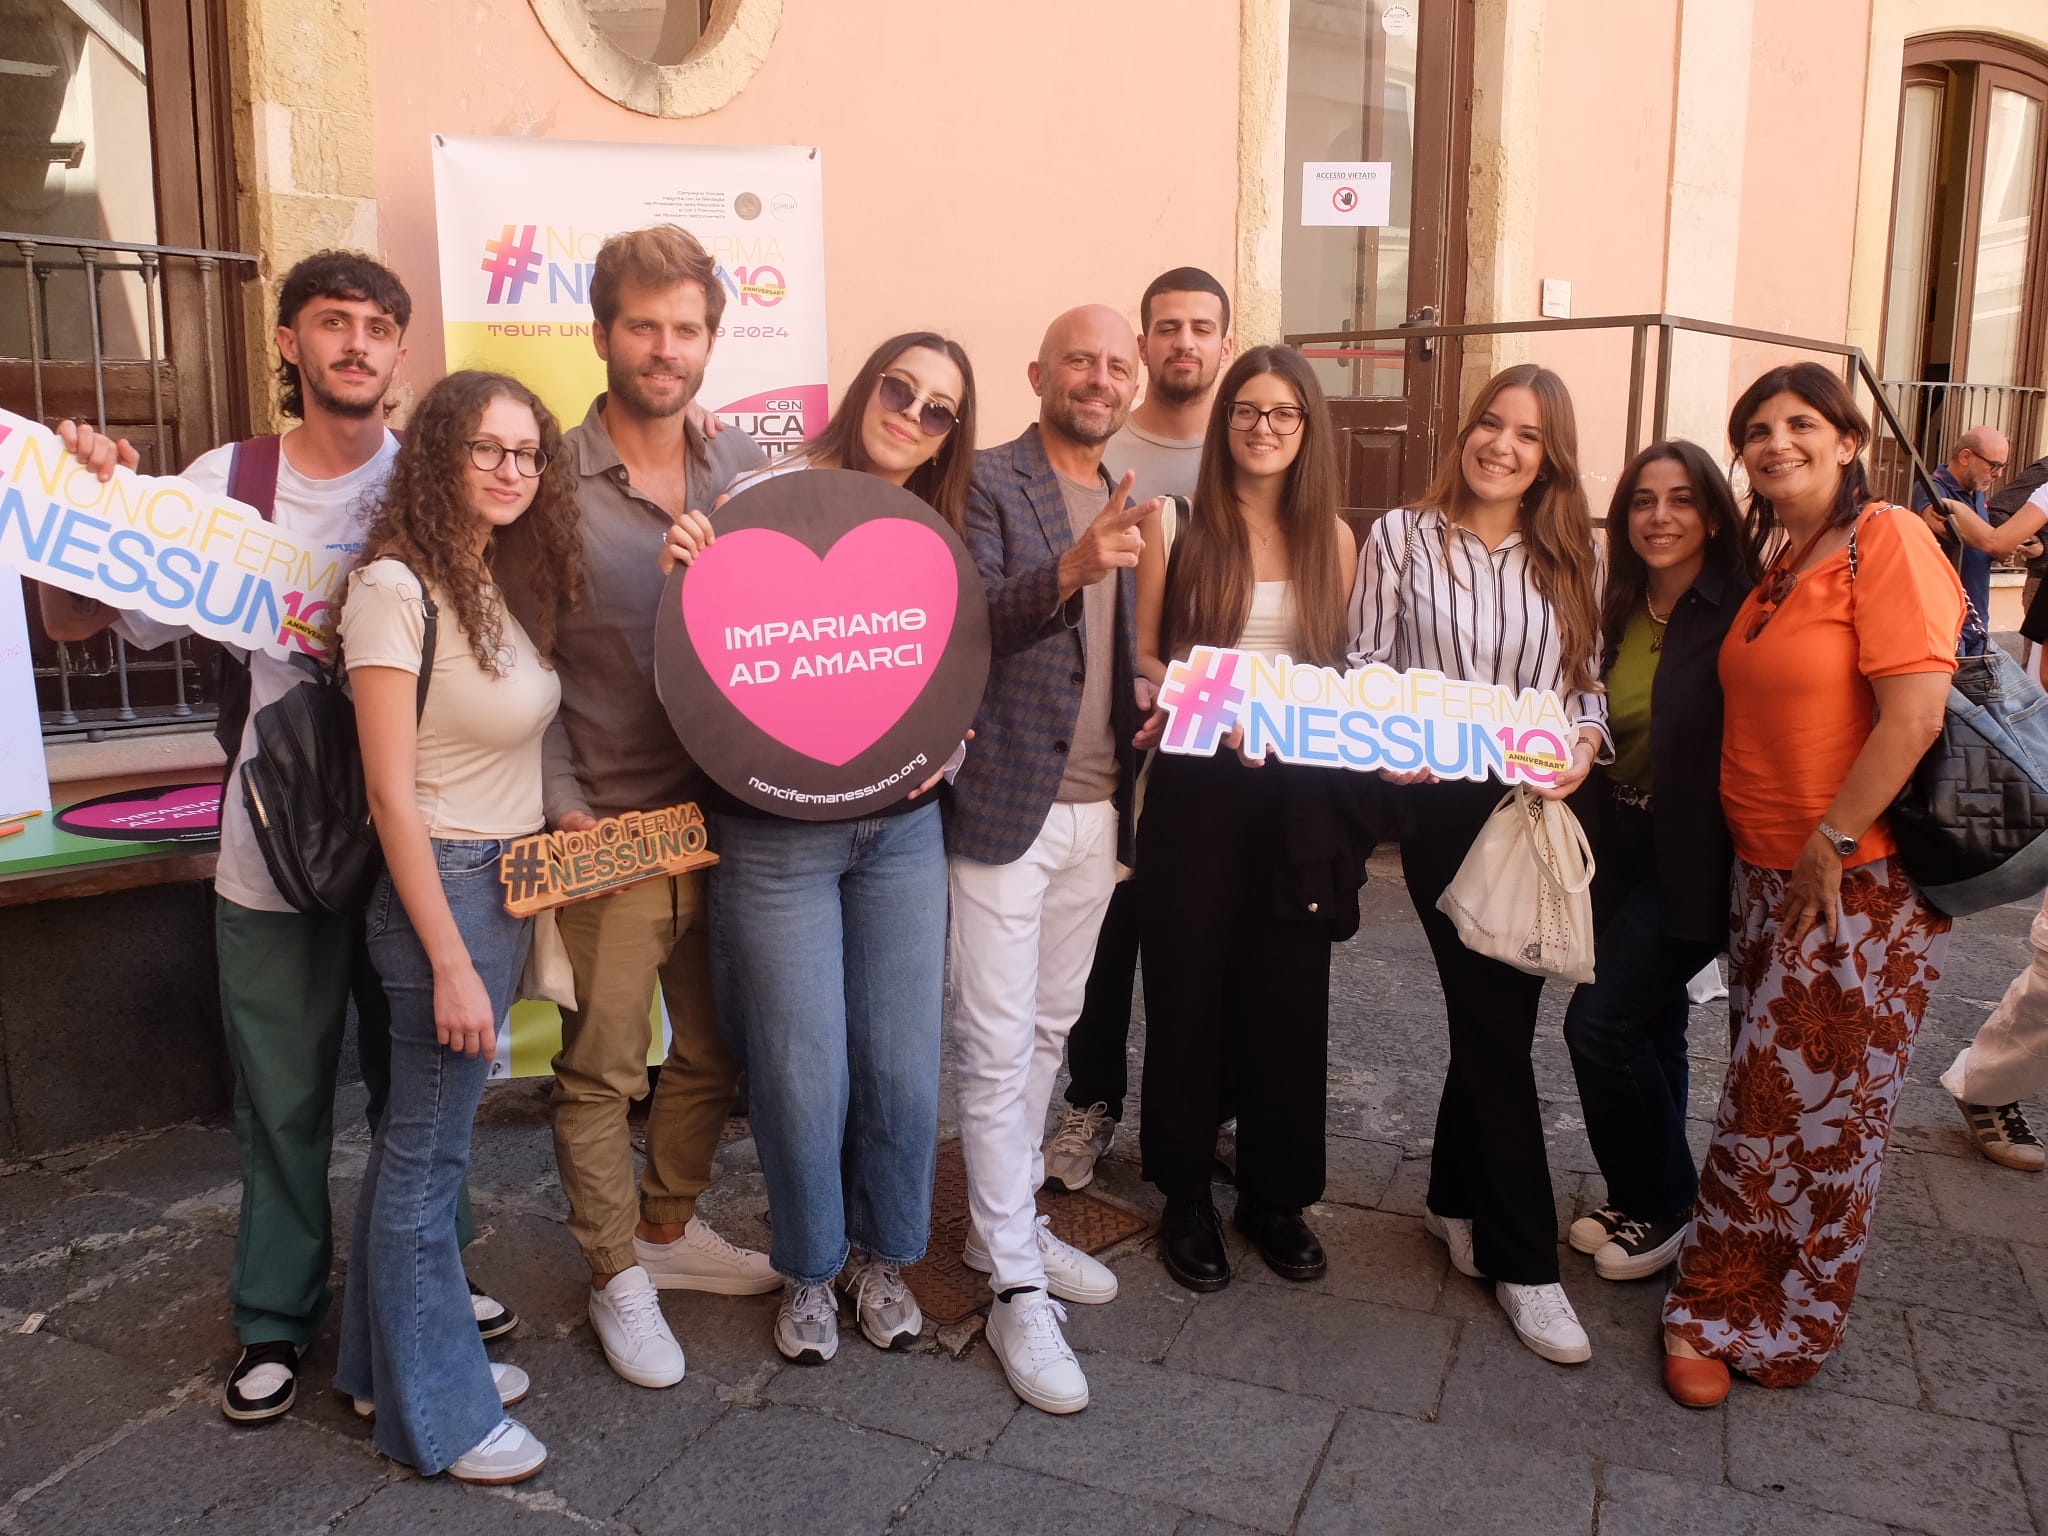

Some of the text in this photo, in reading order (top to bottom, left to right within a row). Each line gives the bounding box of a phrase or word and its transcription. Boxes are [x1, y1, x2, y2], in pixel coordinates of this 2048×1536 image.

[742, 286, 785, 296] ANNIVERSARY
[488, 325, 551, 336] TOUR
[733, 326, 790, 338] 2024
[766, 401, 802, 410] CON
[717, 415, 805, 436] UCA
[725, 608, 927, 650] IMPARIAMO
[729, 643, 923, 687] AD AMARCI
[1508, 751, 1566, 771] ANNIVERSARY
[748, 753, 928, 804] noncifermanessuno.org
[129, 816, 165, 828] AD
